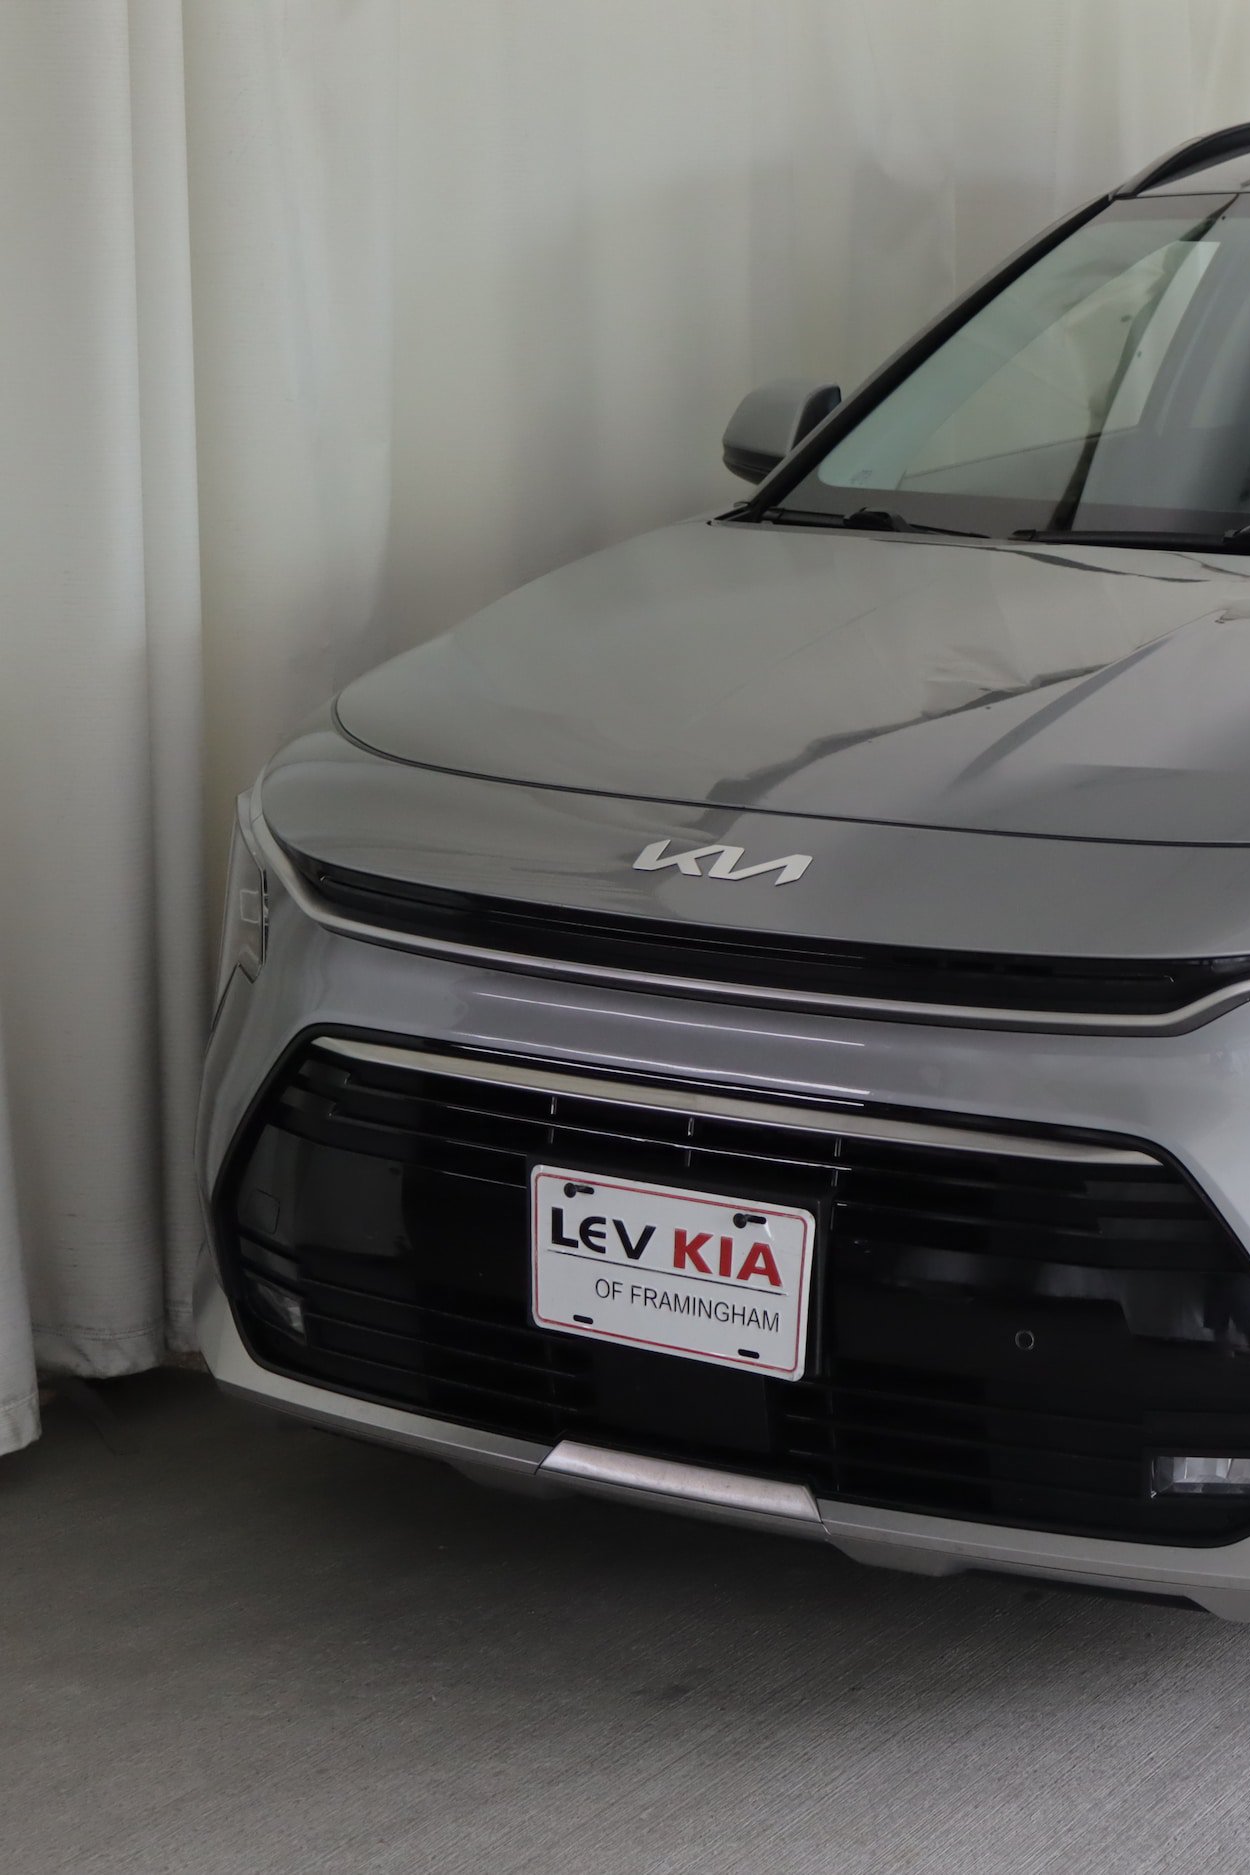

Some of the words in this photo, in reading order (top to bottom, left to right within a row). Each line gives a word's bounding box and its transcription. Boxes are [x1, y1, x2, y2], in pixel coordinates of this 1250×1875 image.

[632, 839, 813, 886] KIA
[550, 1206, 657, 1260] LEV
[673, 1228, 783, 1288] KIA
[594, 1278, 623, 1301] OF
[630, 1285, 780, 1333] FRAMINGHAM
